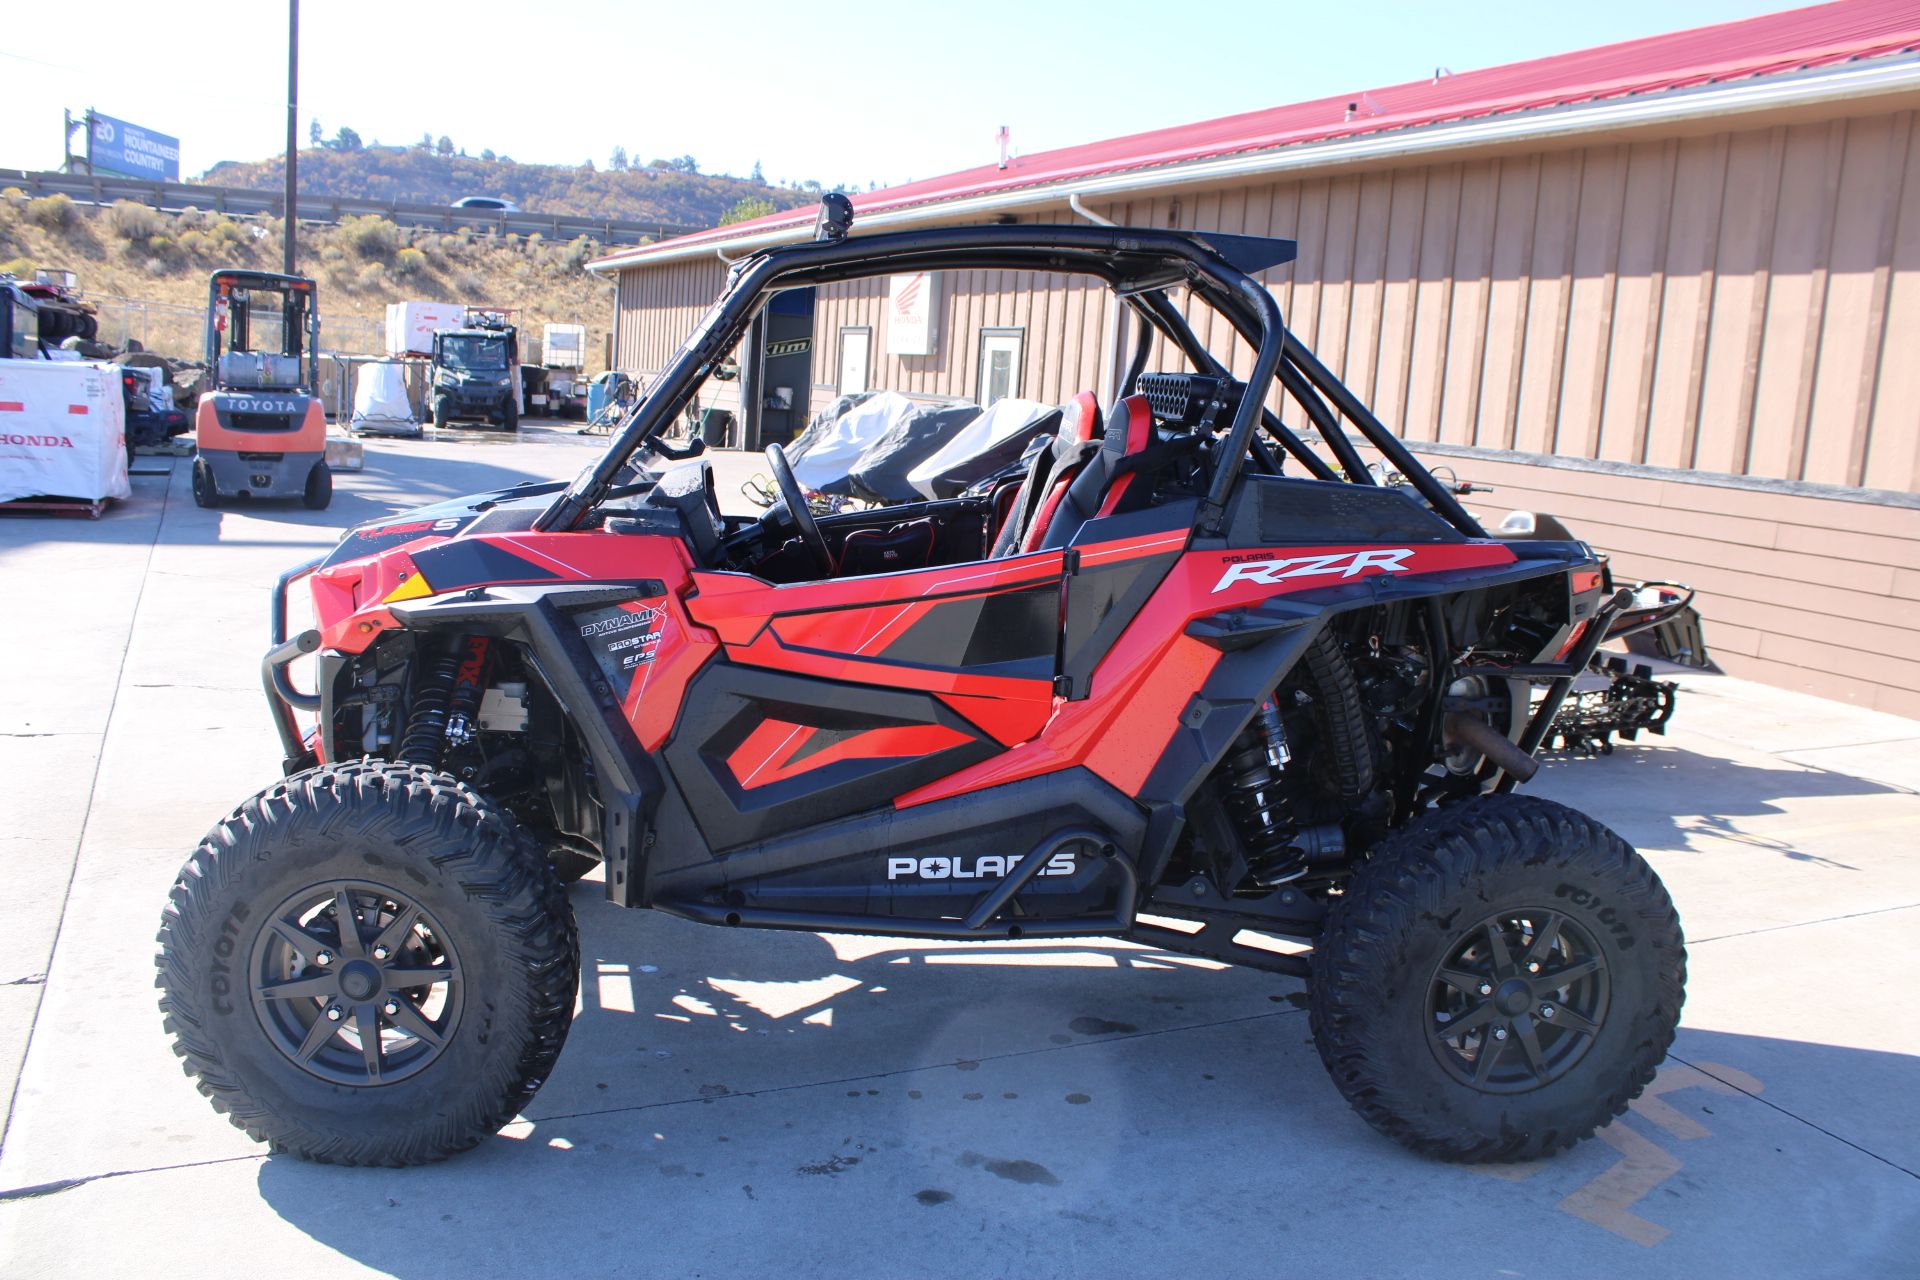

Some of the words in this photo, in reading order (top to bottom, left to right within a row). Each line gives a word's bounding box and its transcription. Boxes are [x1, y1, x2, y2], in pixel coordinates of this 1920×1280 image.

[124, 148, 164, 173] COUNTRY!
[227, 399, 297, 412] TOYOTA
[0, 434, 74, 448] HONDA
[432, 517, 461, 531] S
[1222, 552, 1275, 564] POLARIS
[1211, 548, 1416, 594] RZR
[580, 600, 668, 637] DYNAMIX
[608, 632, 662, 652] PROSTAR
[623, 650, 656, 665] EPS
[888, 853, 1076, 880] POLAS
[210, 899, 250, 1016] COYOTE
